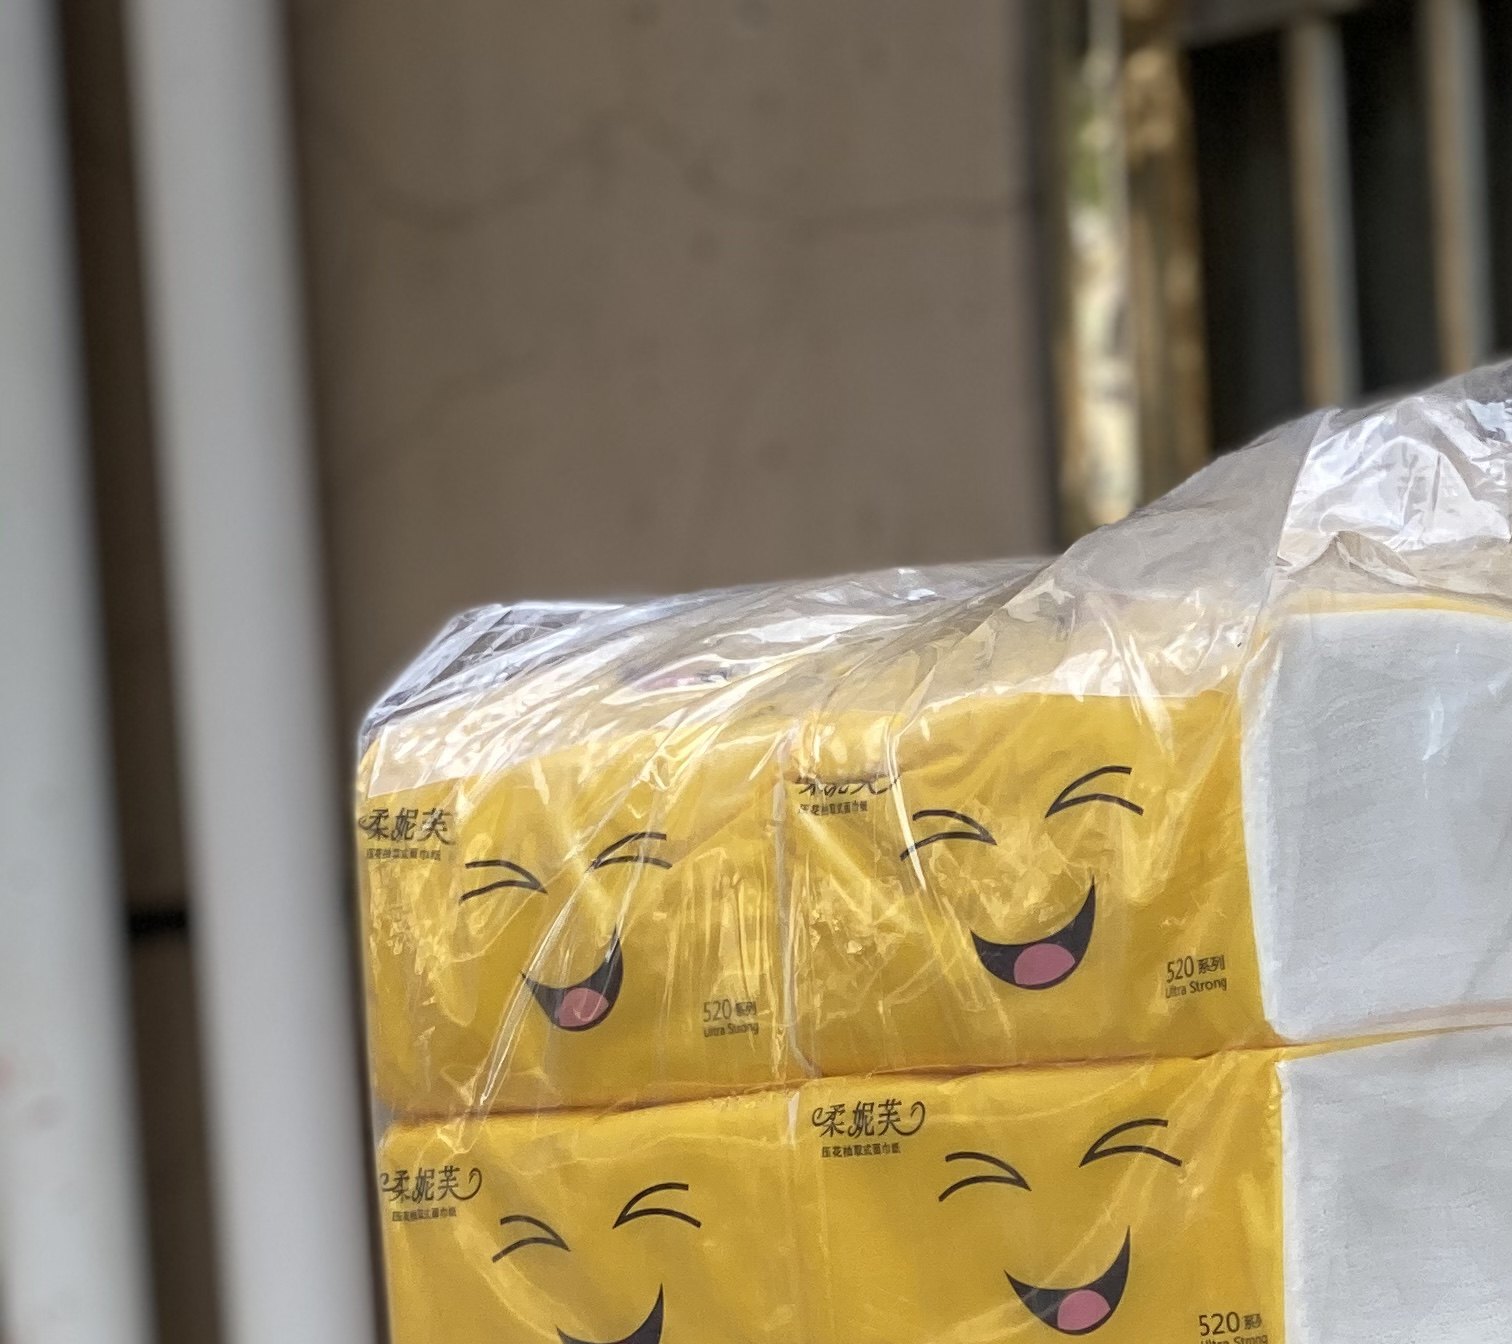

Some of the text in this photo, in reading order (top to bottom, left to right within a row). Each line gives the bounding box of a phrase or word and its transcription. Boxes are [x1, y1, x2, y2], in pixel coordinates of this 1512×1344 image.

[1165, 977, 1227, 999] Ultra Strong
[704, 1022, 759, 1037] Ultra Strong
[812, 1098, 925, 1139] 柔妮芙
[380, 1165, 482, 1204] 柔妮芙
